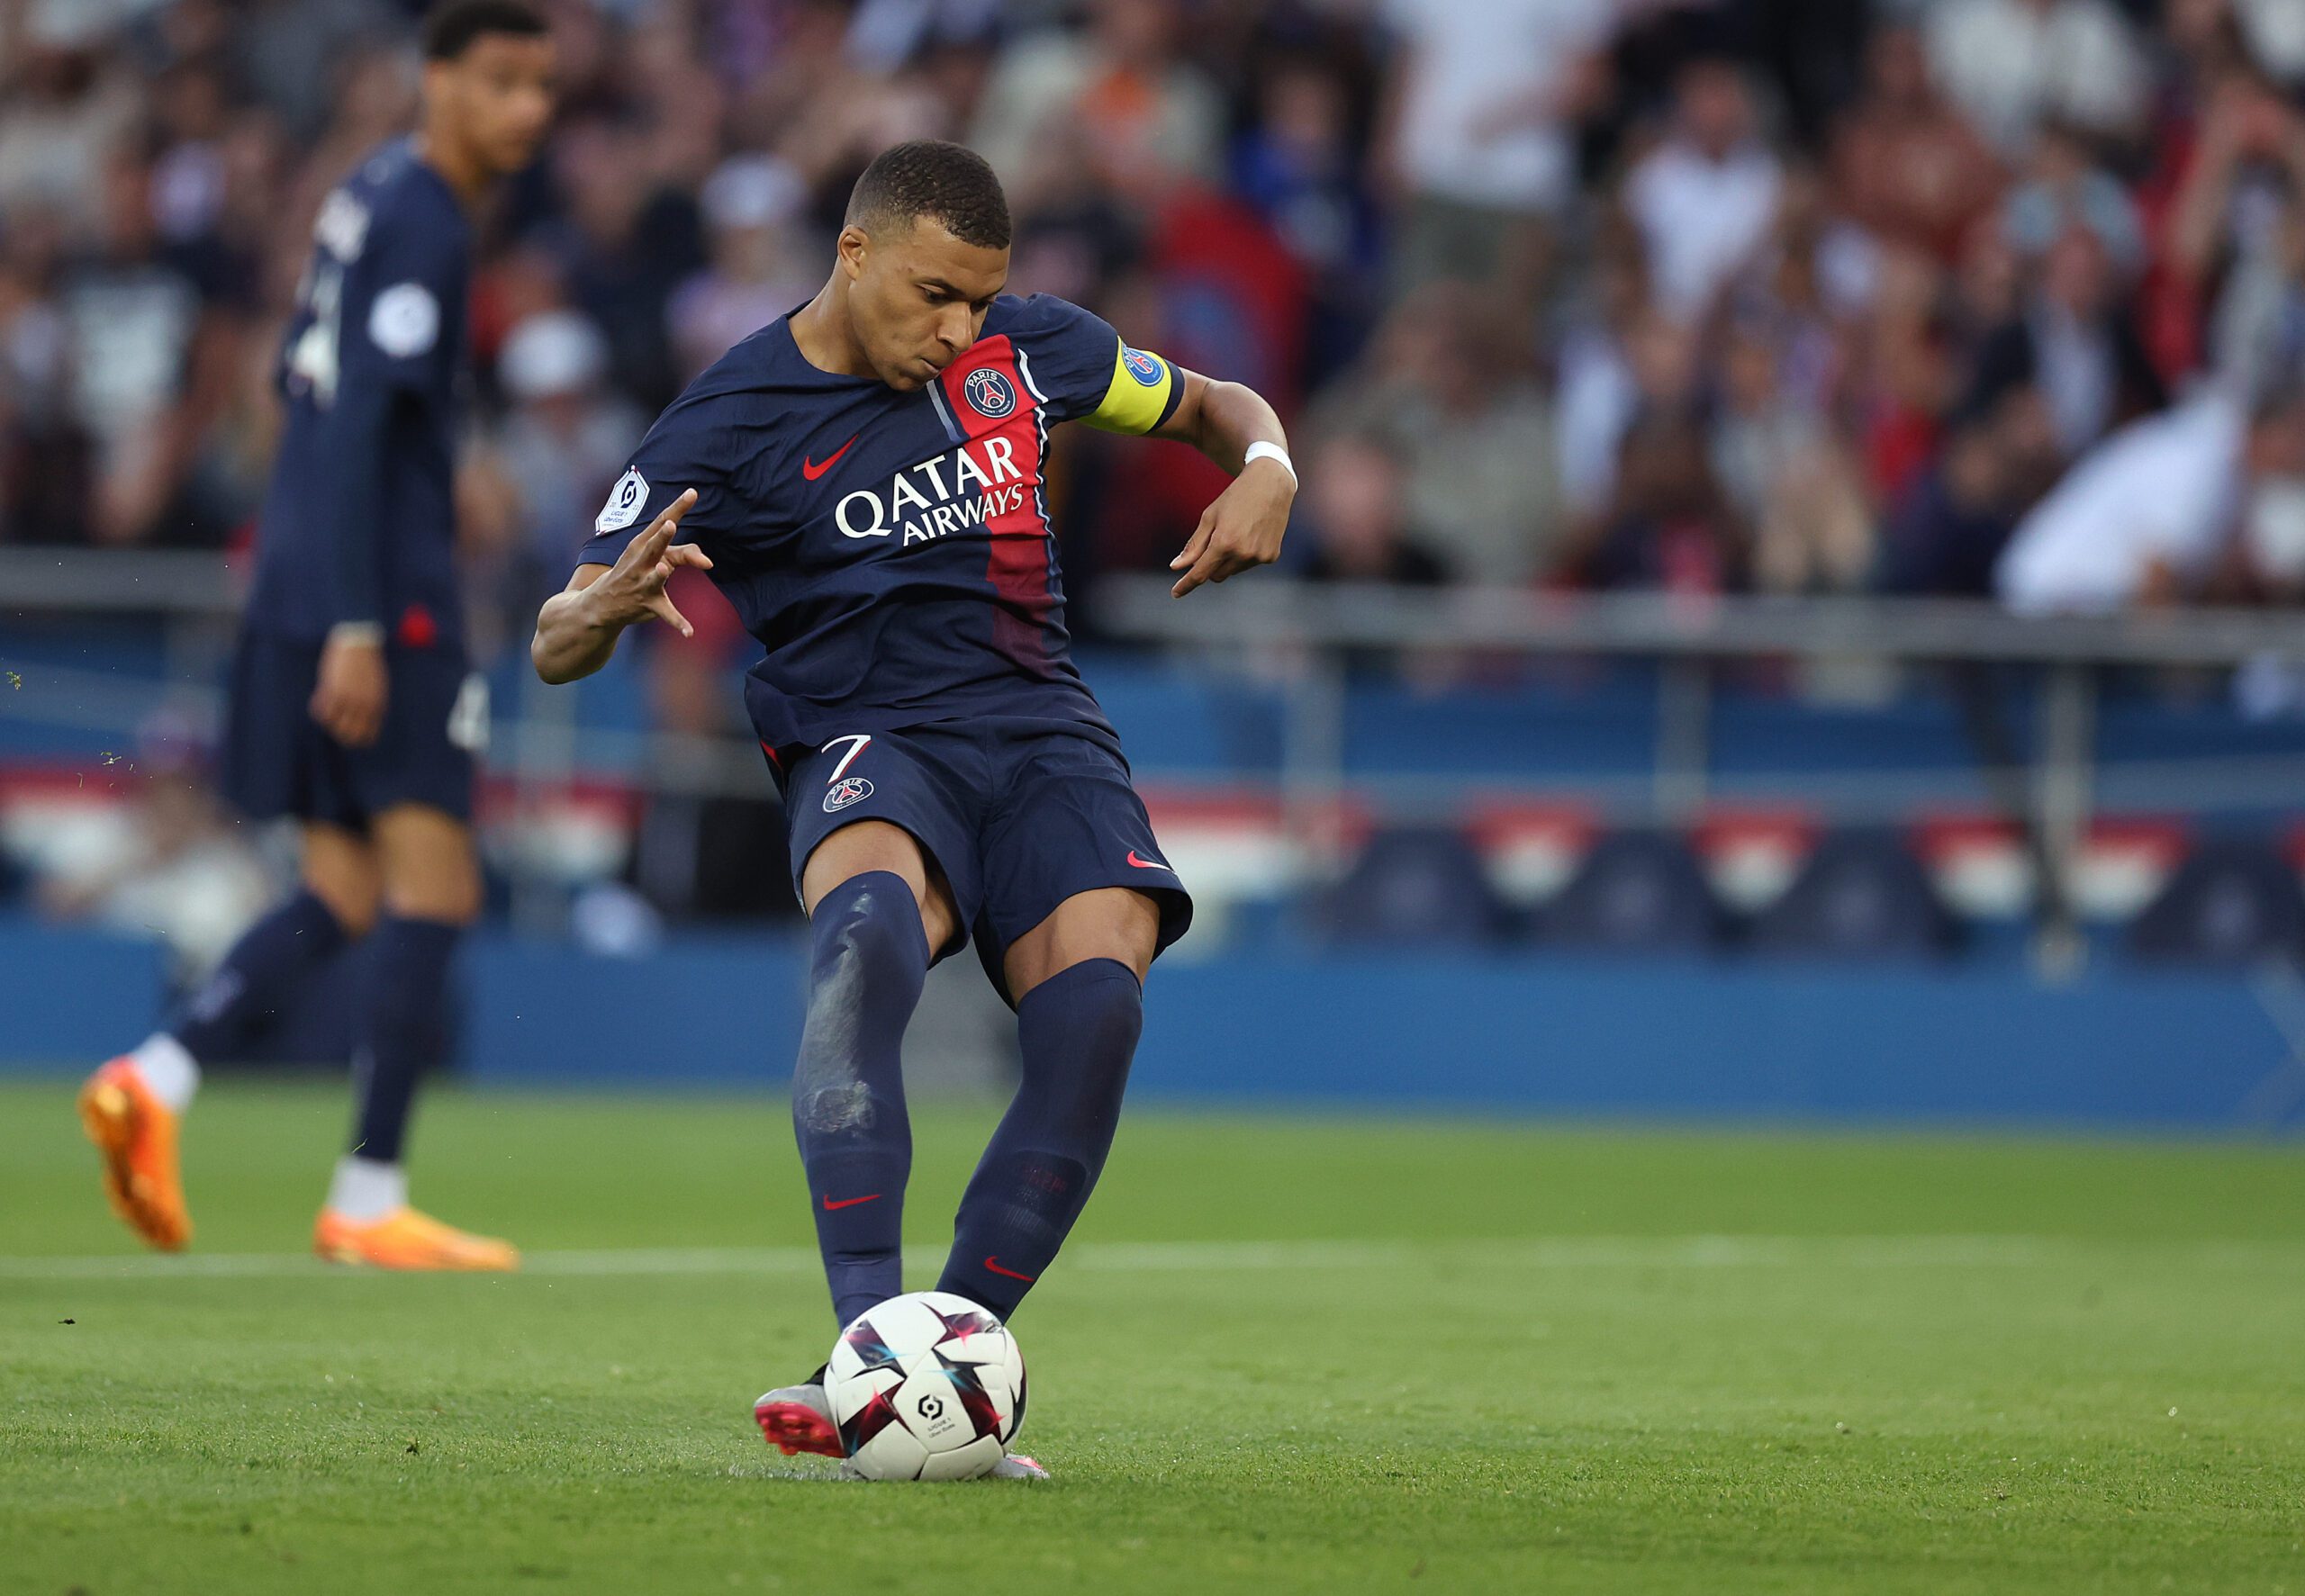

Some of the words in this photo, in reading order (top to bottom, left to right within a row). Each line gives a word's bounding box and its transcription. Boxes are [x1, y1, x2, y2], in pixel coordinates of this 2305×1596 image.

[967, 371, 998, 387] PARIS
[835, 436, 1023, 538] QATAR
[903, 483, 1023, 547] AIRWAYS
[821, 735, 872, 785] 7
[927, 1420, 946, 1431] LIGUE
